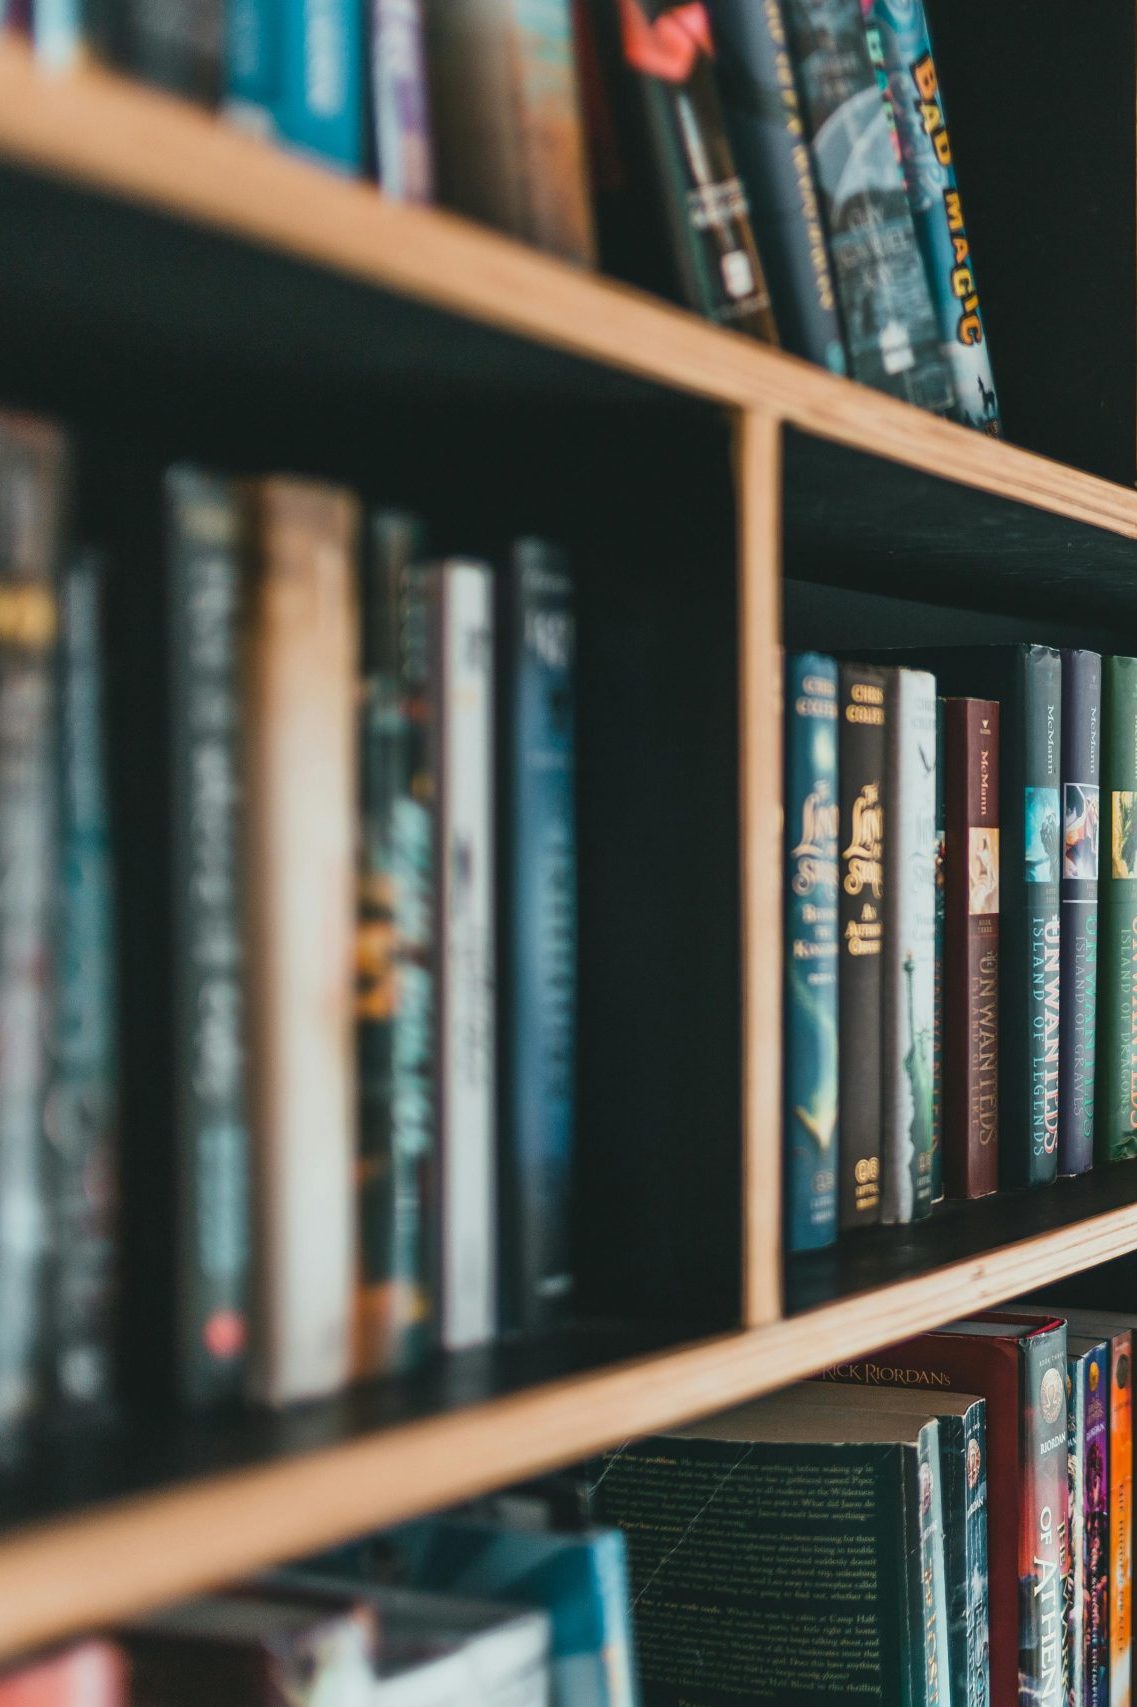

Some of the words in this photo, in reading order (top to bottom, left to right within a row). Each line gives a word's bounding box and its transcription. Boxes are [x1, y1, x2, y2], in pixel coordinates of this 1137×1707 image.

[909, 51, 952, 167] BAD
[942, 187, 983, 348] MAGIC
[1047, 703, 1057, 775] McMann
[1088, 703, 1098, 774] McMann
[979, 749, 990, 816] McMann
[1033, 918, 1045, 1001] ISLAND
[1075, 935, 1085, 1003] ISLAND
[1121, 928, 1132, 993] ISLAND
[970, 977, 980, 1043] ISLAND
[1033, 1015, 1045, 1042] OF
[1044, 919, 1061, 1155] UNWANTEDS
[1075, 1013, 1085, 1034] OF
[1083, 914, 1098, 1138] UNWANTEDS
[1121, 1002, 1132, 1022] OF
[979, 957, 999, 1146] UNWANTEDS
[1073, 1044, 1085, 1117] GRAVES
[1120, 1032, 1132, 1116] DRAGONS
[1033, 1061, 1045, 1158] LEGENDS
[822, 1363, 863, 1381] RICK
[864, 1362, 952, 1386] RIORDAN's
[1040, 1431, 1067, 1455] RIORDAN
[1039, 1506, 1053, 1545] OF
[1056, 1511, 1069, 1569] THE
[1033, 1555, 1058, 1707] ATHEN
